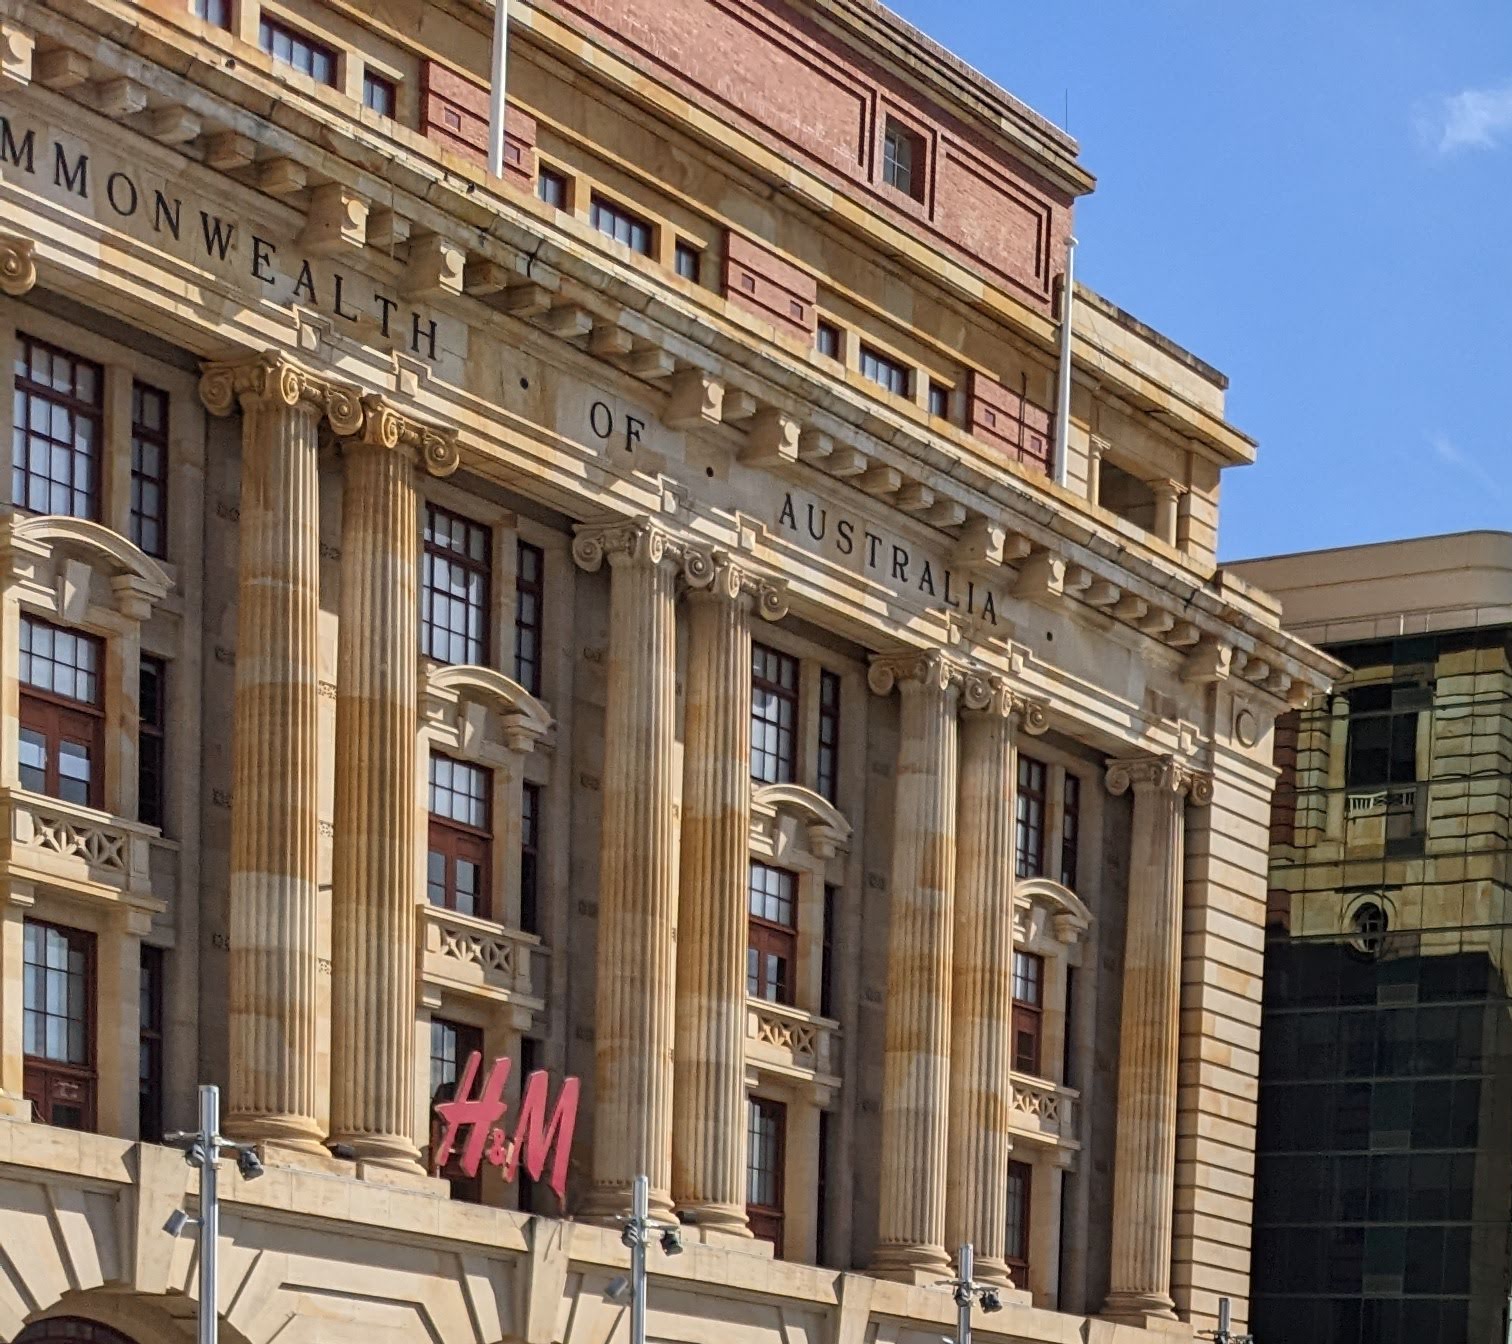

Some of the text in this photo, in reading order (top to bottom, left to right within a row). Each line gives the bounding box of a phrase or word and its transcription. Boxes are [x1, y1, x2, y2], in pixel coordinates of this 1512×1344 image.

[589, 400, 646, 453] OF
[778, 491, 1000, 628] AUSTRALIA
[434, 1050, 582, 1213] H&M
